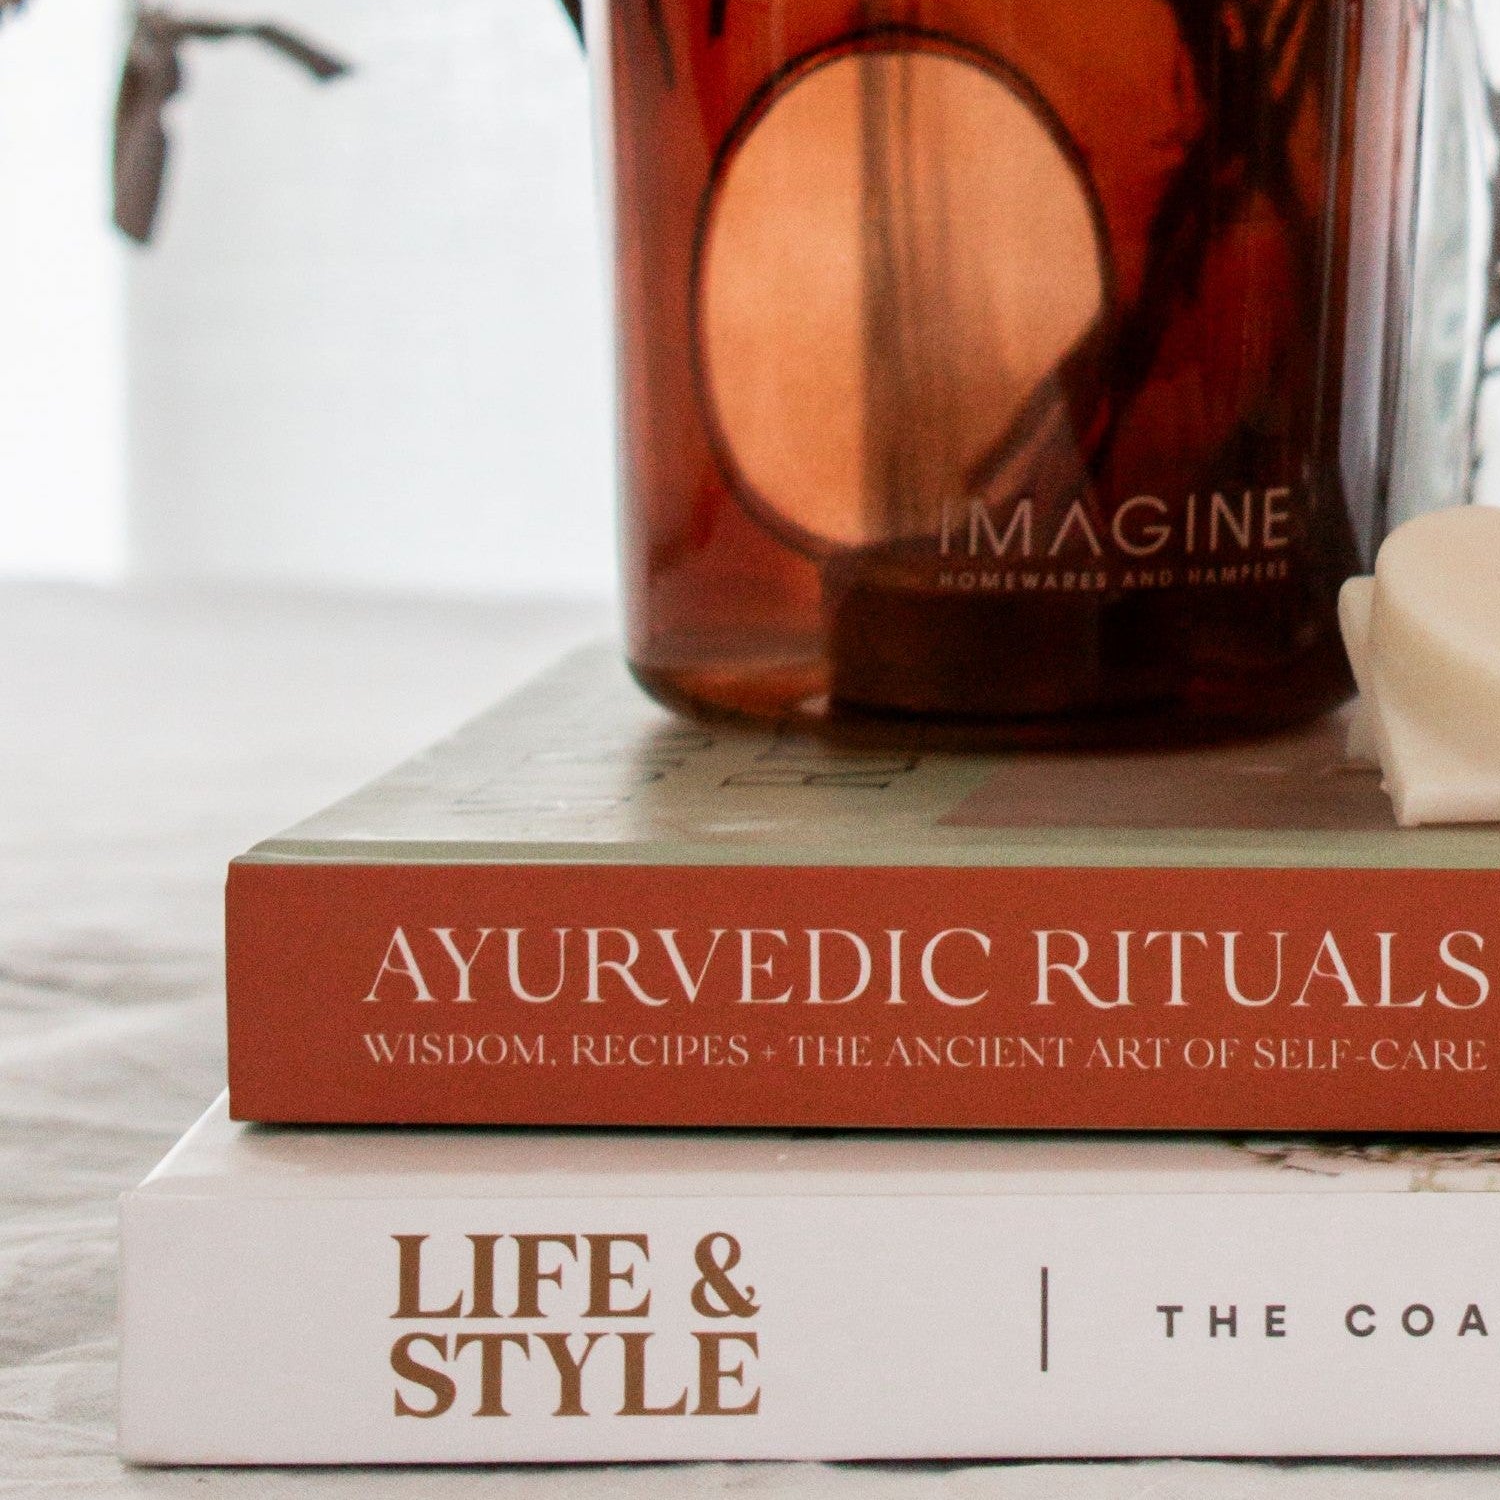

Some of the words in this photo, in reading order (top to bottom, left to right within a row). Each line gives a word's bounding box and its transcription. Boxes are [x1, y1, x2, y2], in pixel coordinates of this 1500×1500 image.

[938, 486, 1292, 558] IMAGINE
[938, 569, 1107, 592] HOMEWARES
[1122, 569, 1174, 589] AND
[363, 926, 992, 1007] AYURVEDIC
[1031, 929, 1490, 1010] RITUALS
[363, 1033, 556, 1065] WISDOM,
[573, 1035, 749, 1066] RECIPES
[789, 1036, 871, 1066] THE
[885, 1037, 1072, 1067] ANCIENT
[1085, 1038, 1169, 1069] ART
[1183, 1039, 1239, 1068] OF
[1254, 1039, 1487, 1071] SELF-CARE
[390, 1233, 651, 1319] LIFE
[690, 1231, 761, 1319] &
[1156, 1304, 1287, 1338] THE
[389, 1331, 761, 1419] STYLE
